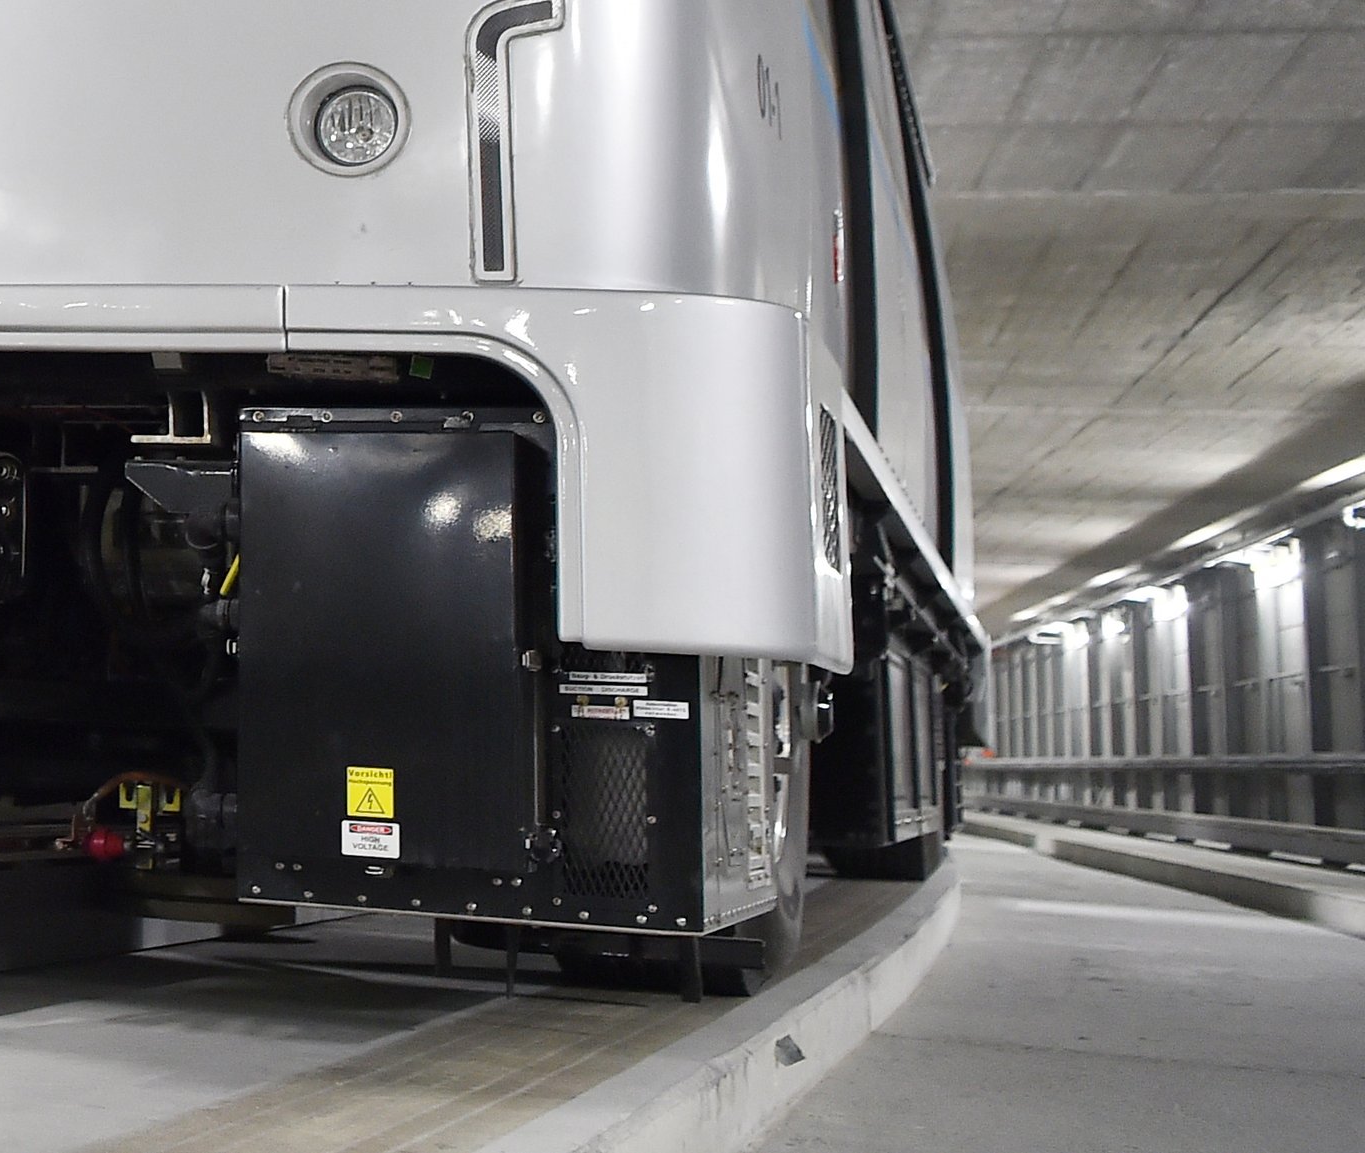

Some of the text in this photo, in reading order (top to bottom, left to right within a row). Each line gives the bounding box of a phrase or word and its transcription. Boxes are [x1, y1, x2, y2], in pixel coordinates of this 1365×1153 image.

[757, 53, 782, 140] 01-1
[348, 769, 392, 779] Vorsicht!
[352, 843, 389, 851] VOLTAGE
